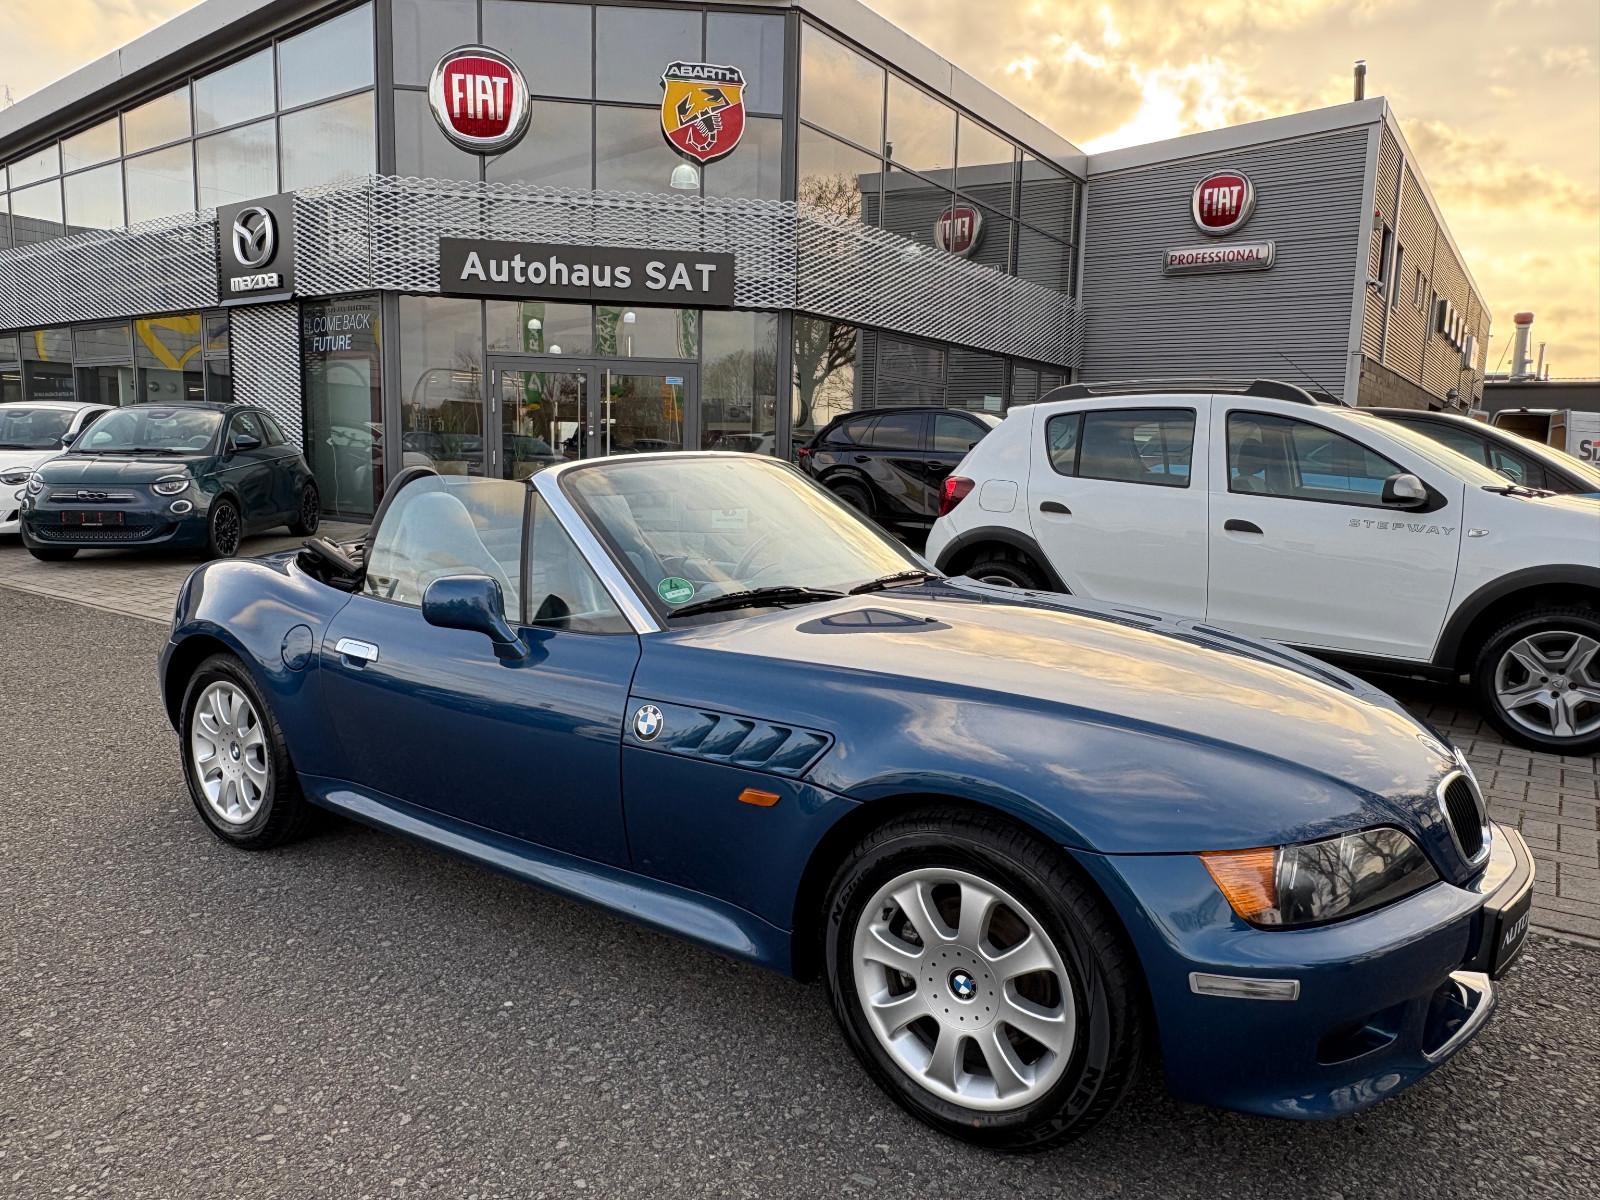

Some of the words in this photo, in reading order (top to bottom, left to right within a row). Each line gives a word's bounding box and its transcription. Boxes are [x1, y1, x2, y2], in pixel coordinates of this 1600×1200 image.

[667, 65, 739, 82] ABARTH
[451, 73, 509, 121] FIAT
[1203, 185, 1242, 217] FIAT
[1169, 248, 1263, 266] PROFESSIONAL
[460, 251, 632, 289] Autohaus
[645, 260, 717, 292] SAT
[342, 313, 370, 330] BACK
[312, 333, 353, 353] FUTURE
[1348, 518, 1456, 536] STEPWAY
